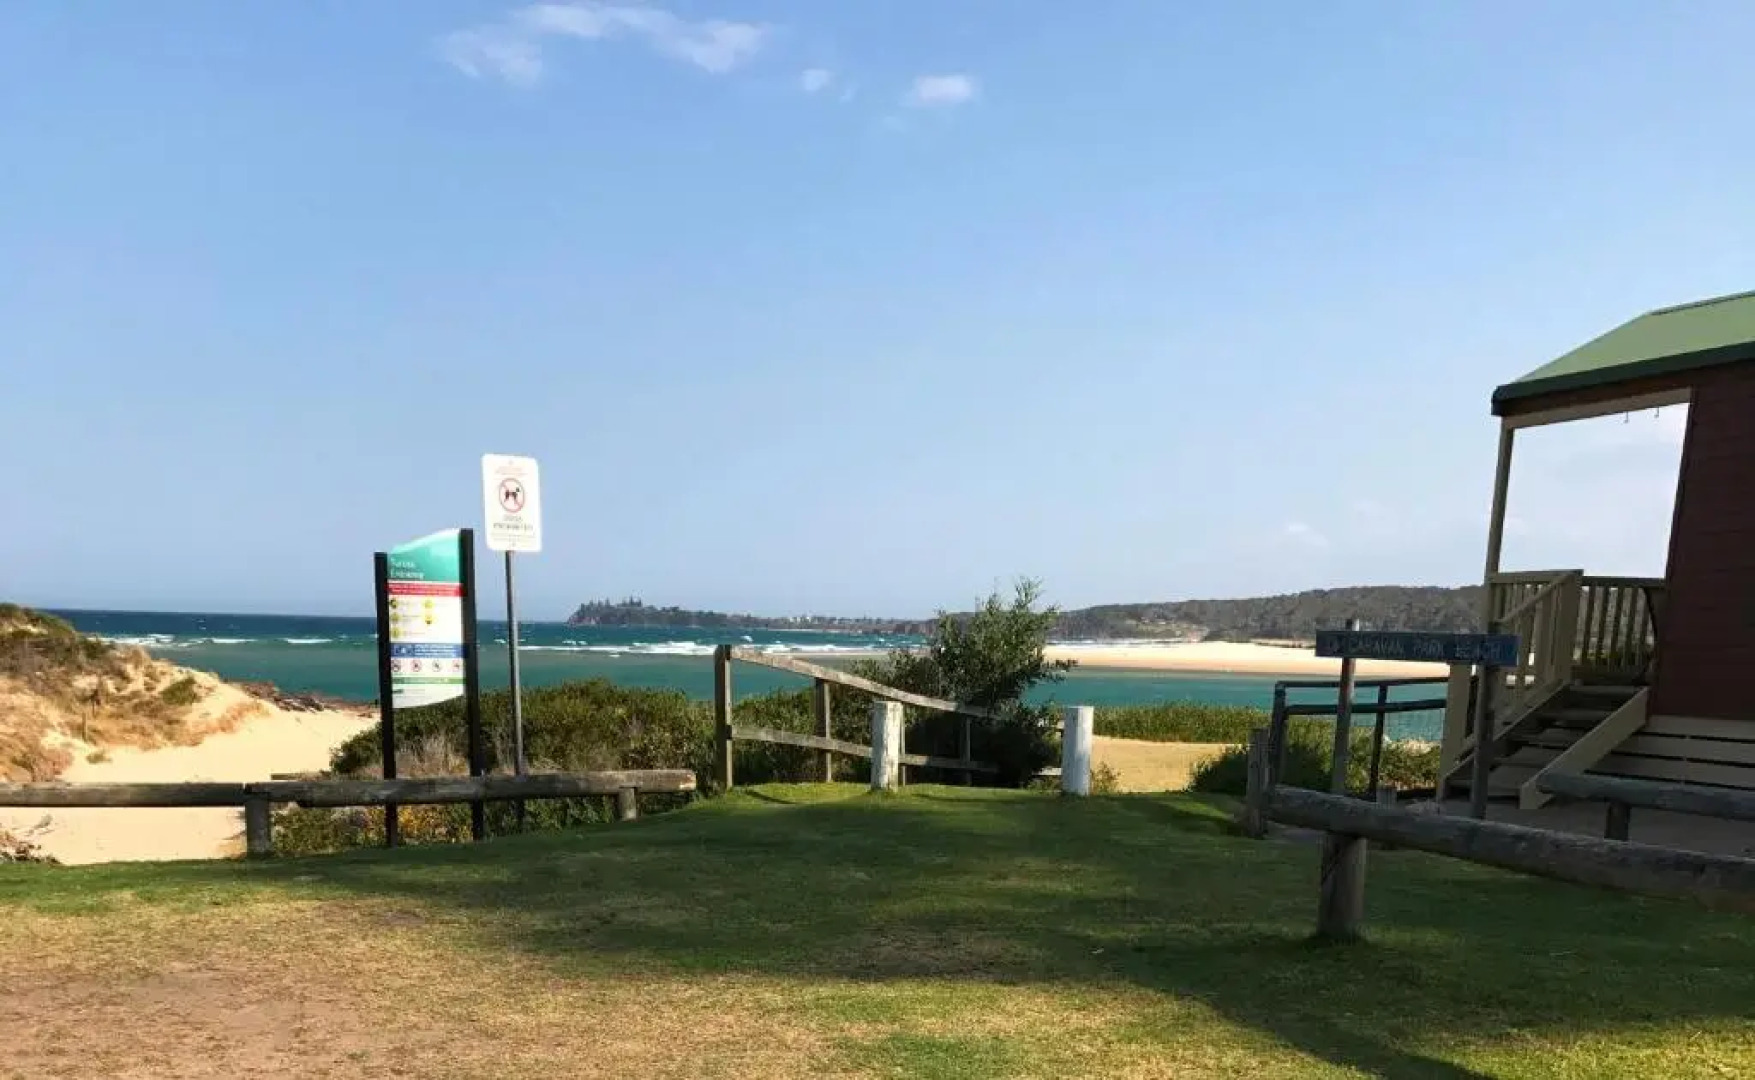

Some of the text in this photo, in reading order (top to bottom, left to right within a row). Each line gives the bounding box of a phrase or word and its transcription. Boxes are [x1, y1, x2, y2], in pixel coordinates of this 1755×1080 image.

[1349, 637, 1503, 660] CARAVAN PARK BEACH
